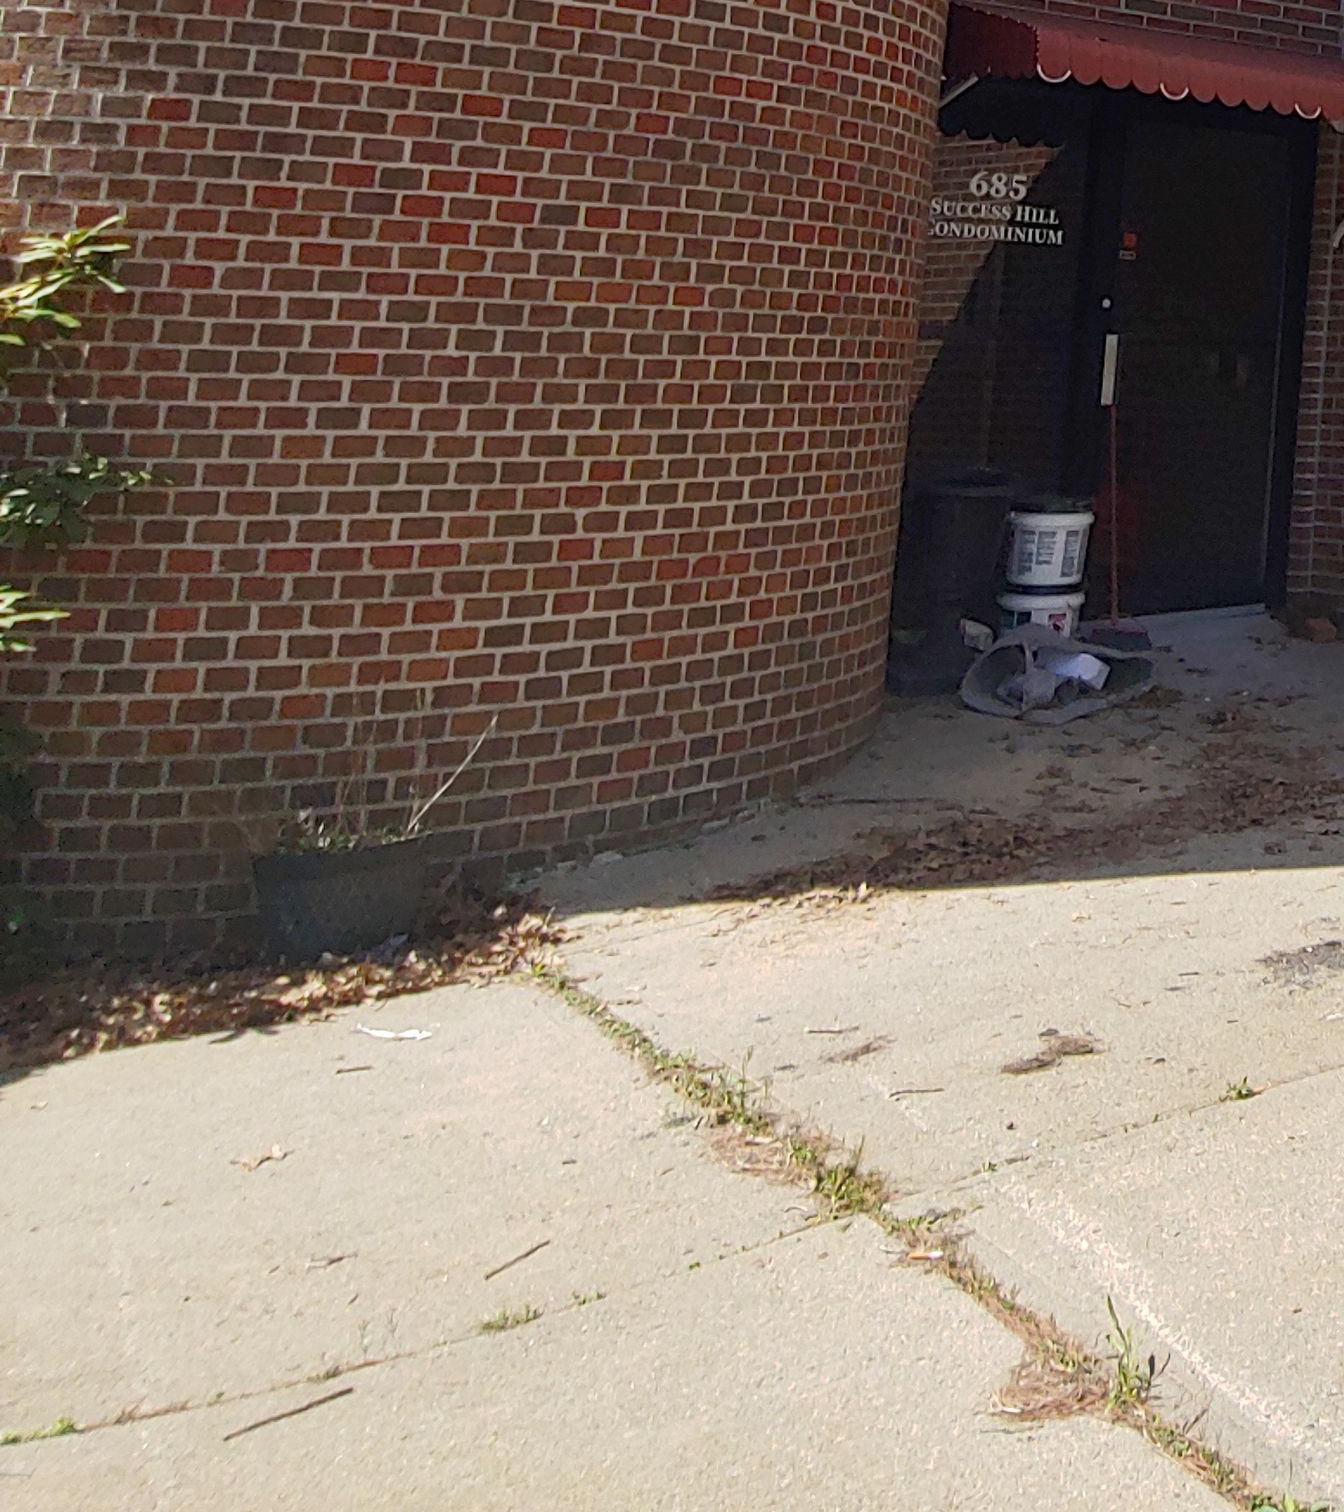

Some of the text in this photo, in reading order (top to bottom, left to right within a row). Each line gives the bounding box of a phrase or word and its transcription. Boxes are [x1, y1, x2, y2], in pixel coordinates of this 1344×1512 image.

[968, 170, 1029, 202] 685
[929, 197, 1060, 225] SUCCESS HILL
